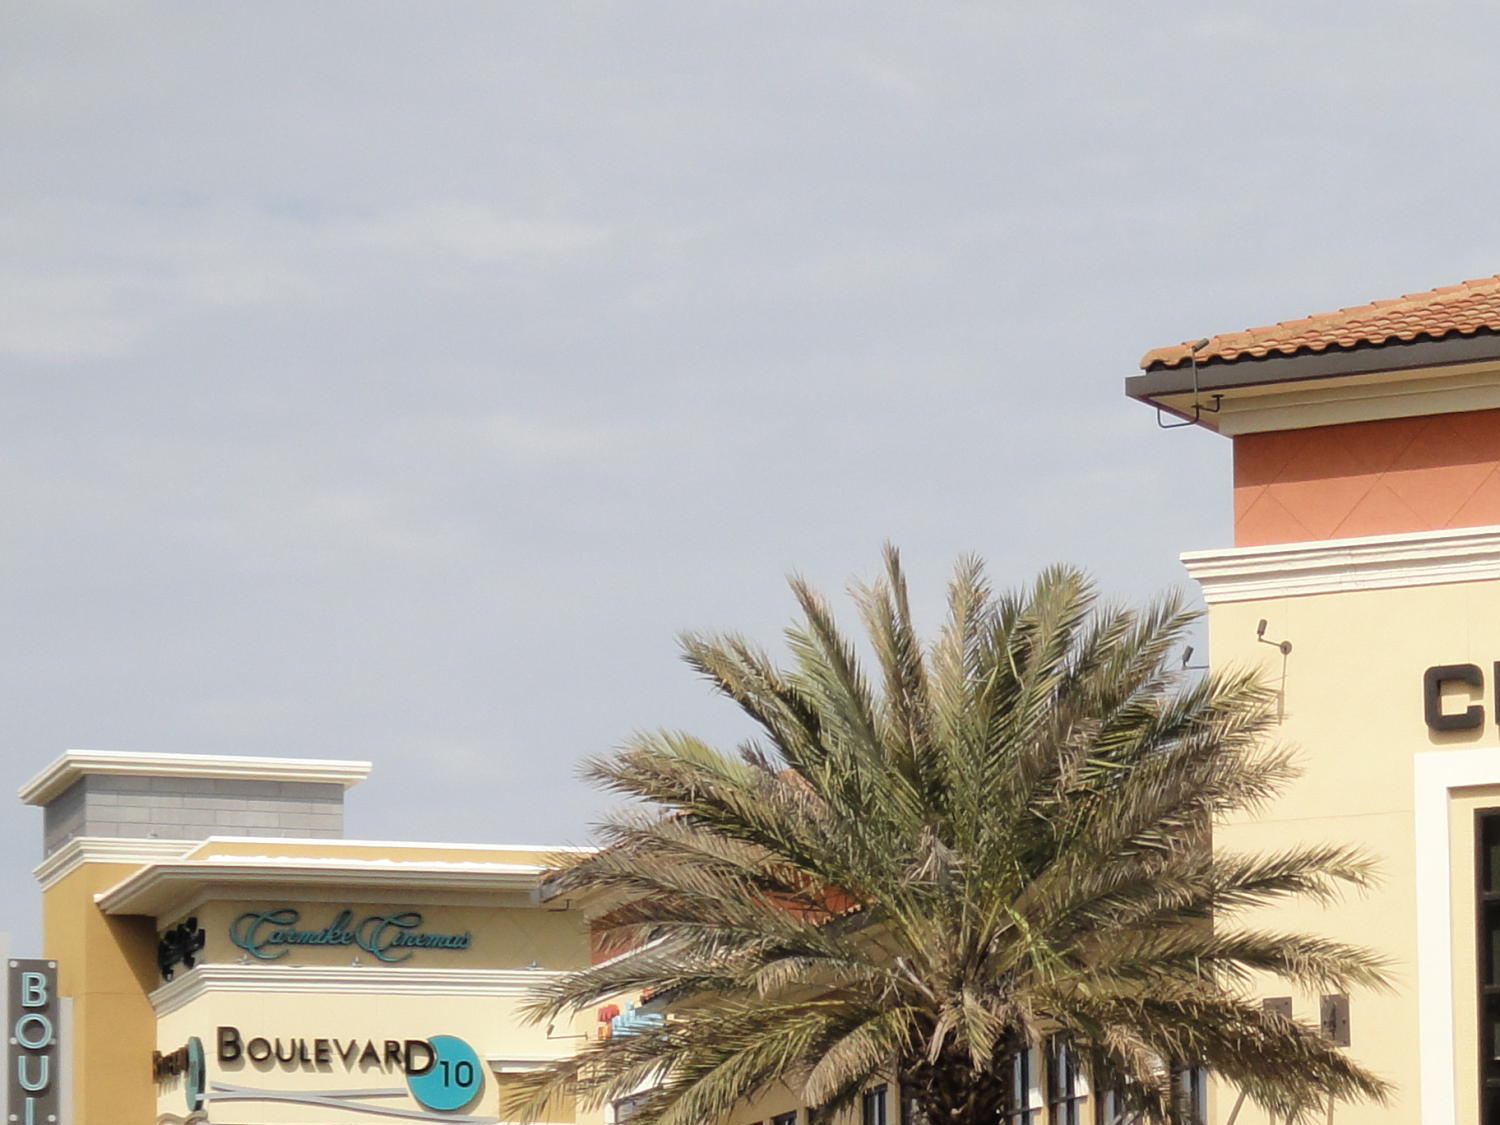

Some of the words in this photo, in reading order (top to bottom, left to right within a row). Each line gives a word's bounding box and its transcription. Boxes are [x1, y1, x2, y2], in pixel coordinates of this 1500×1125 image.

[229, 908, 353, 960] Carmike
[354, 911, 473, 963] Cinemas
[216, 1026, 436, 1076] BOULEVARD
[439, 1060, 474, 1089] 10
